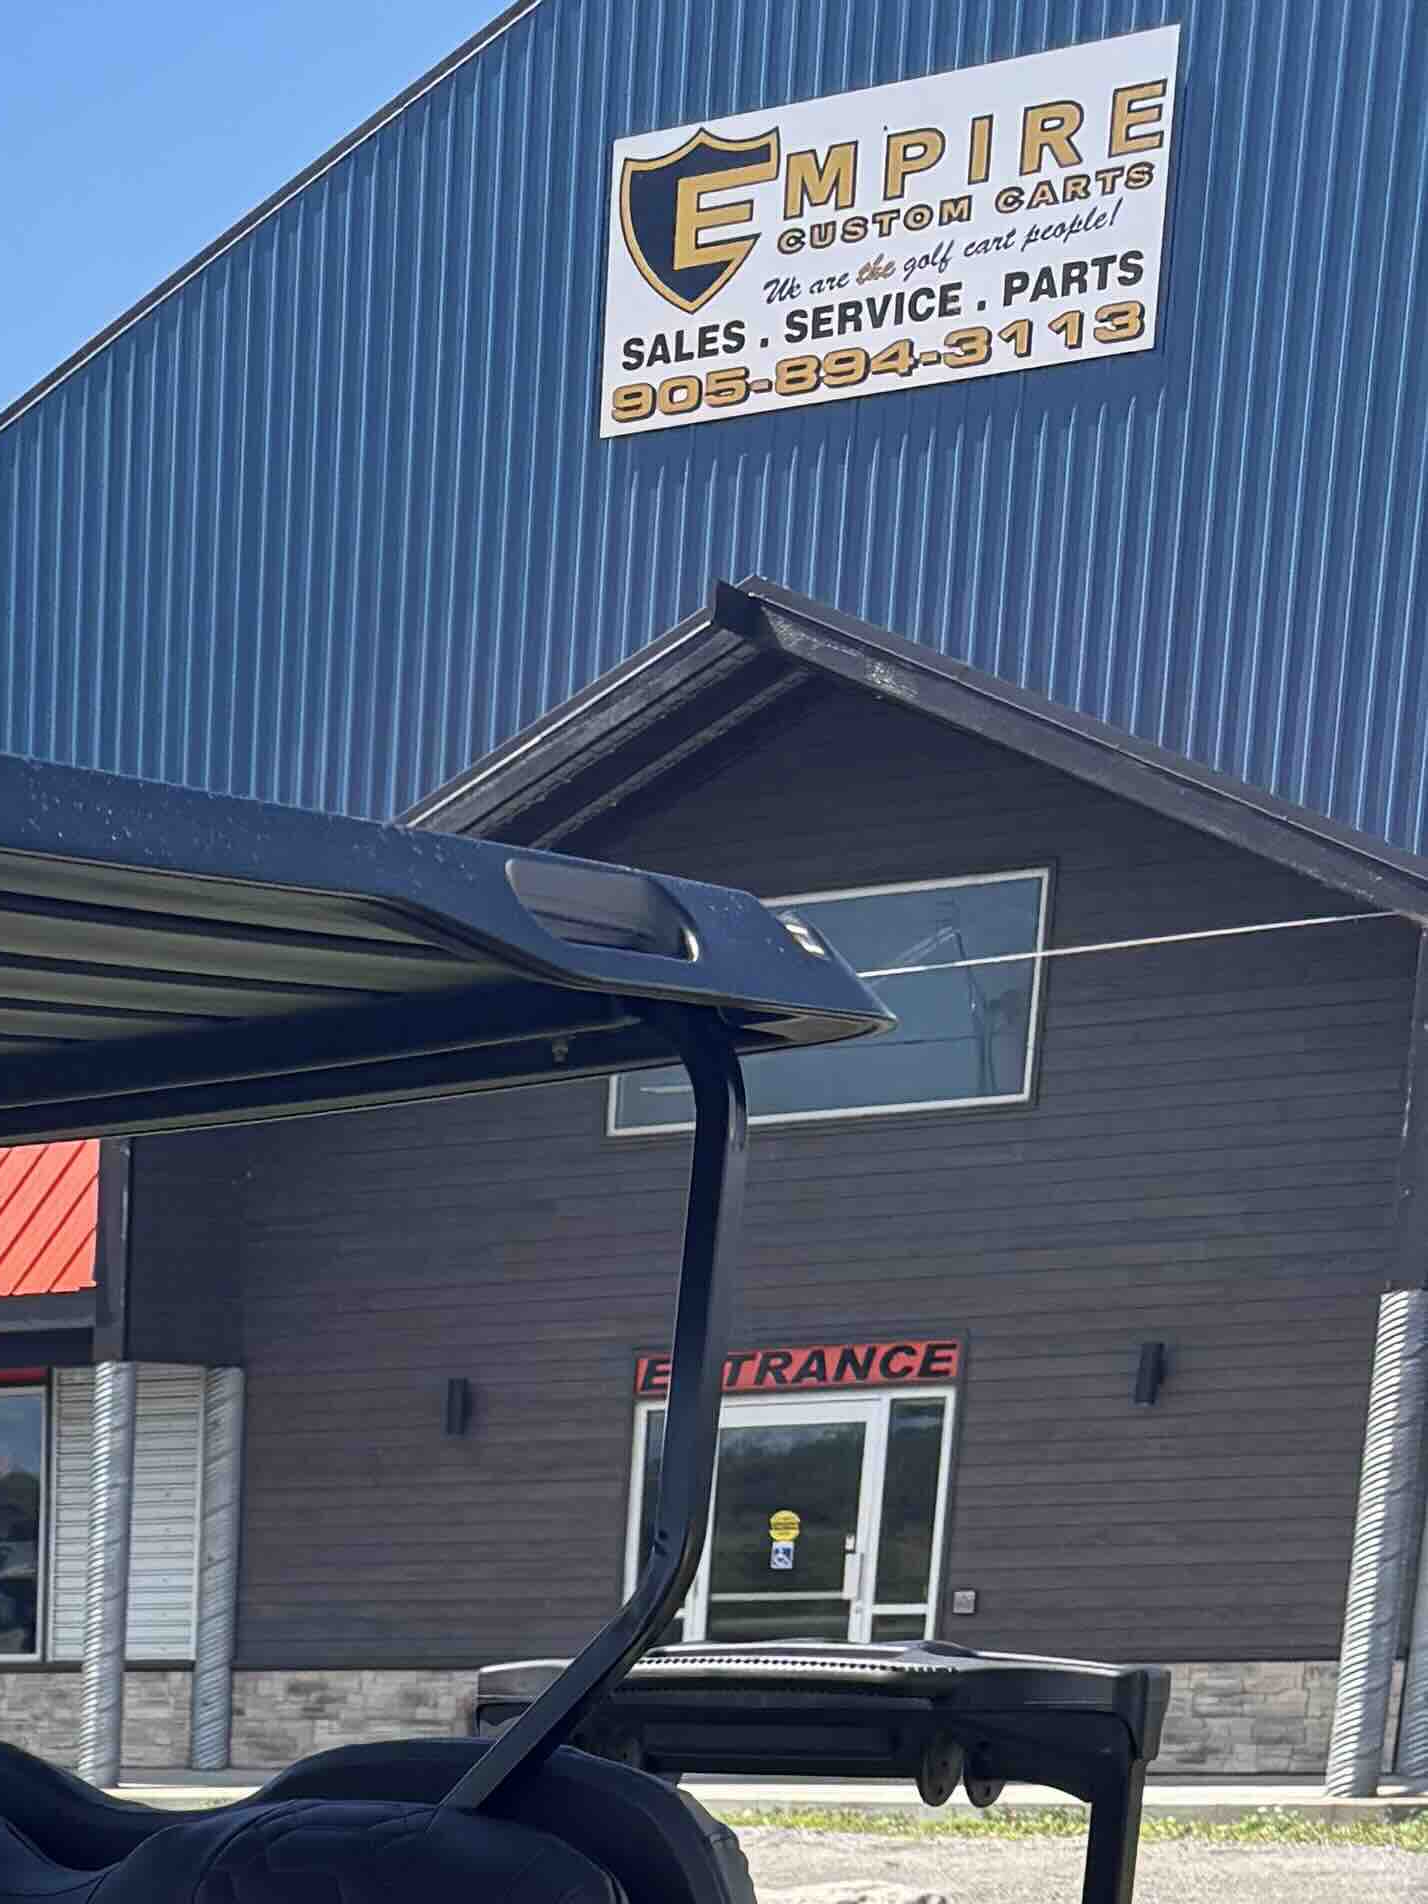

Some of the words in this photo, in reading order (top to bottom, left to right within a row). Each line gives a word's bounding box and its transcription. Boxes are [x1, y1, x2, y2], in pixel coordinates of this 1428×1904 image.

[673, 79, 1168, 271] EMPIRE
[776, 195, 973, 255] CUSTOM
[994, 160, 1155, 214] CARTS
[762, 275, 801, 304] We
[808, 270, 850, 293] are
[855, 253, 897, 284] the
[902, 239, 954, 282] golf
[963, 227, 1017, 257] cart
[1020, 196, 1124, 252] people!
[611, 299, 1145, 424] 905-894-3113
[621, 319, 747, 371] SALES
[784, 281, 963, 344] SERVICE
[1002, 249, 1145, 307] PARTS
[640, 1343, 957, 1391] ETRANCE
